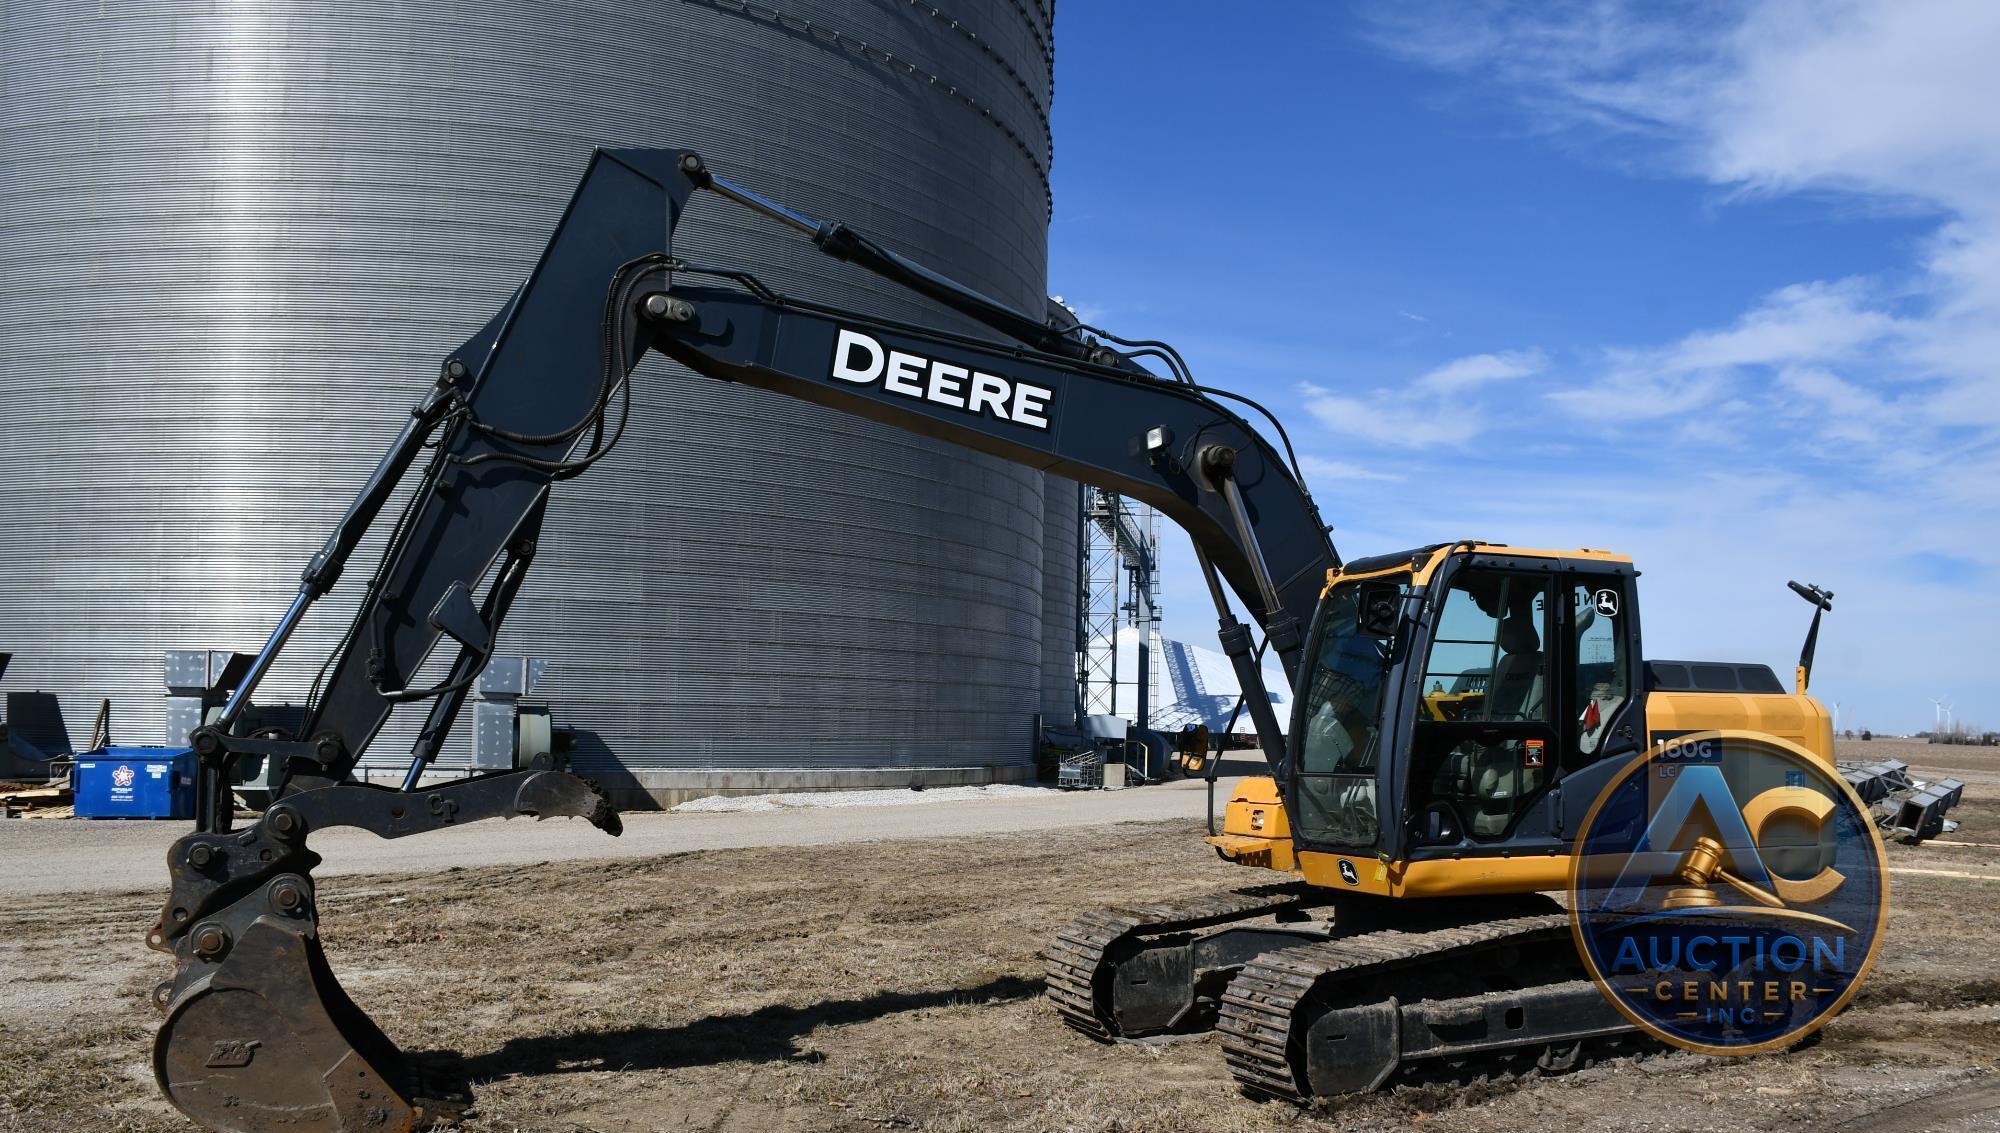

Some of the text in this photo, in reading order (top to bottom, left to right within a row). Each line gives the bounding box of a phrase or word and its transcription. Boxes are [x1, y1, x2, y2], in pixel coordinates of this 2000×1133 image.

[831, 328, 1052, 429] DEERE
[1657, 738, 1712, 758] 160G
[1659, 765, 1676, 778] LC
